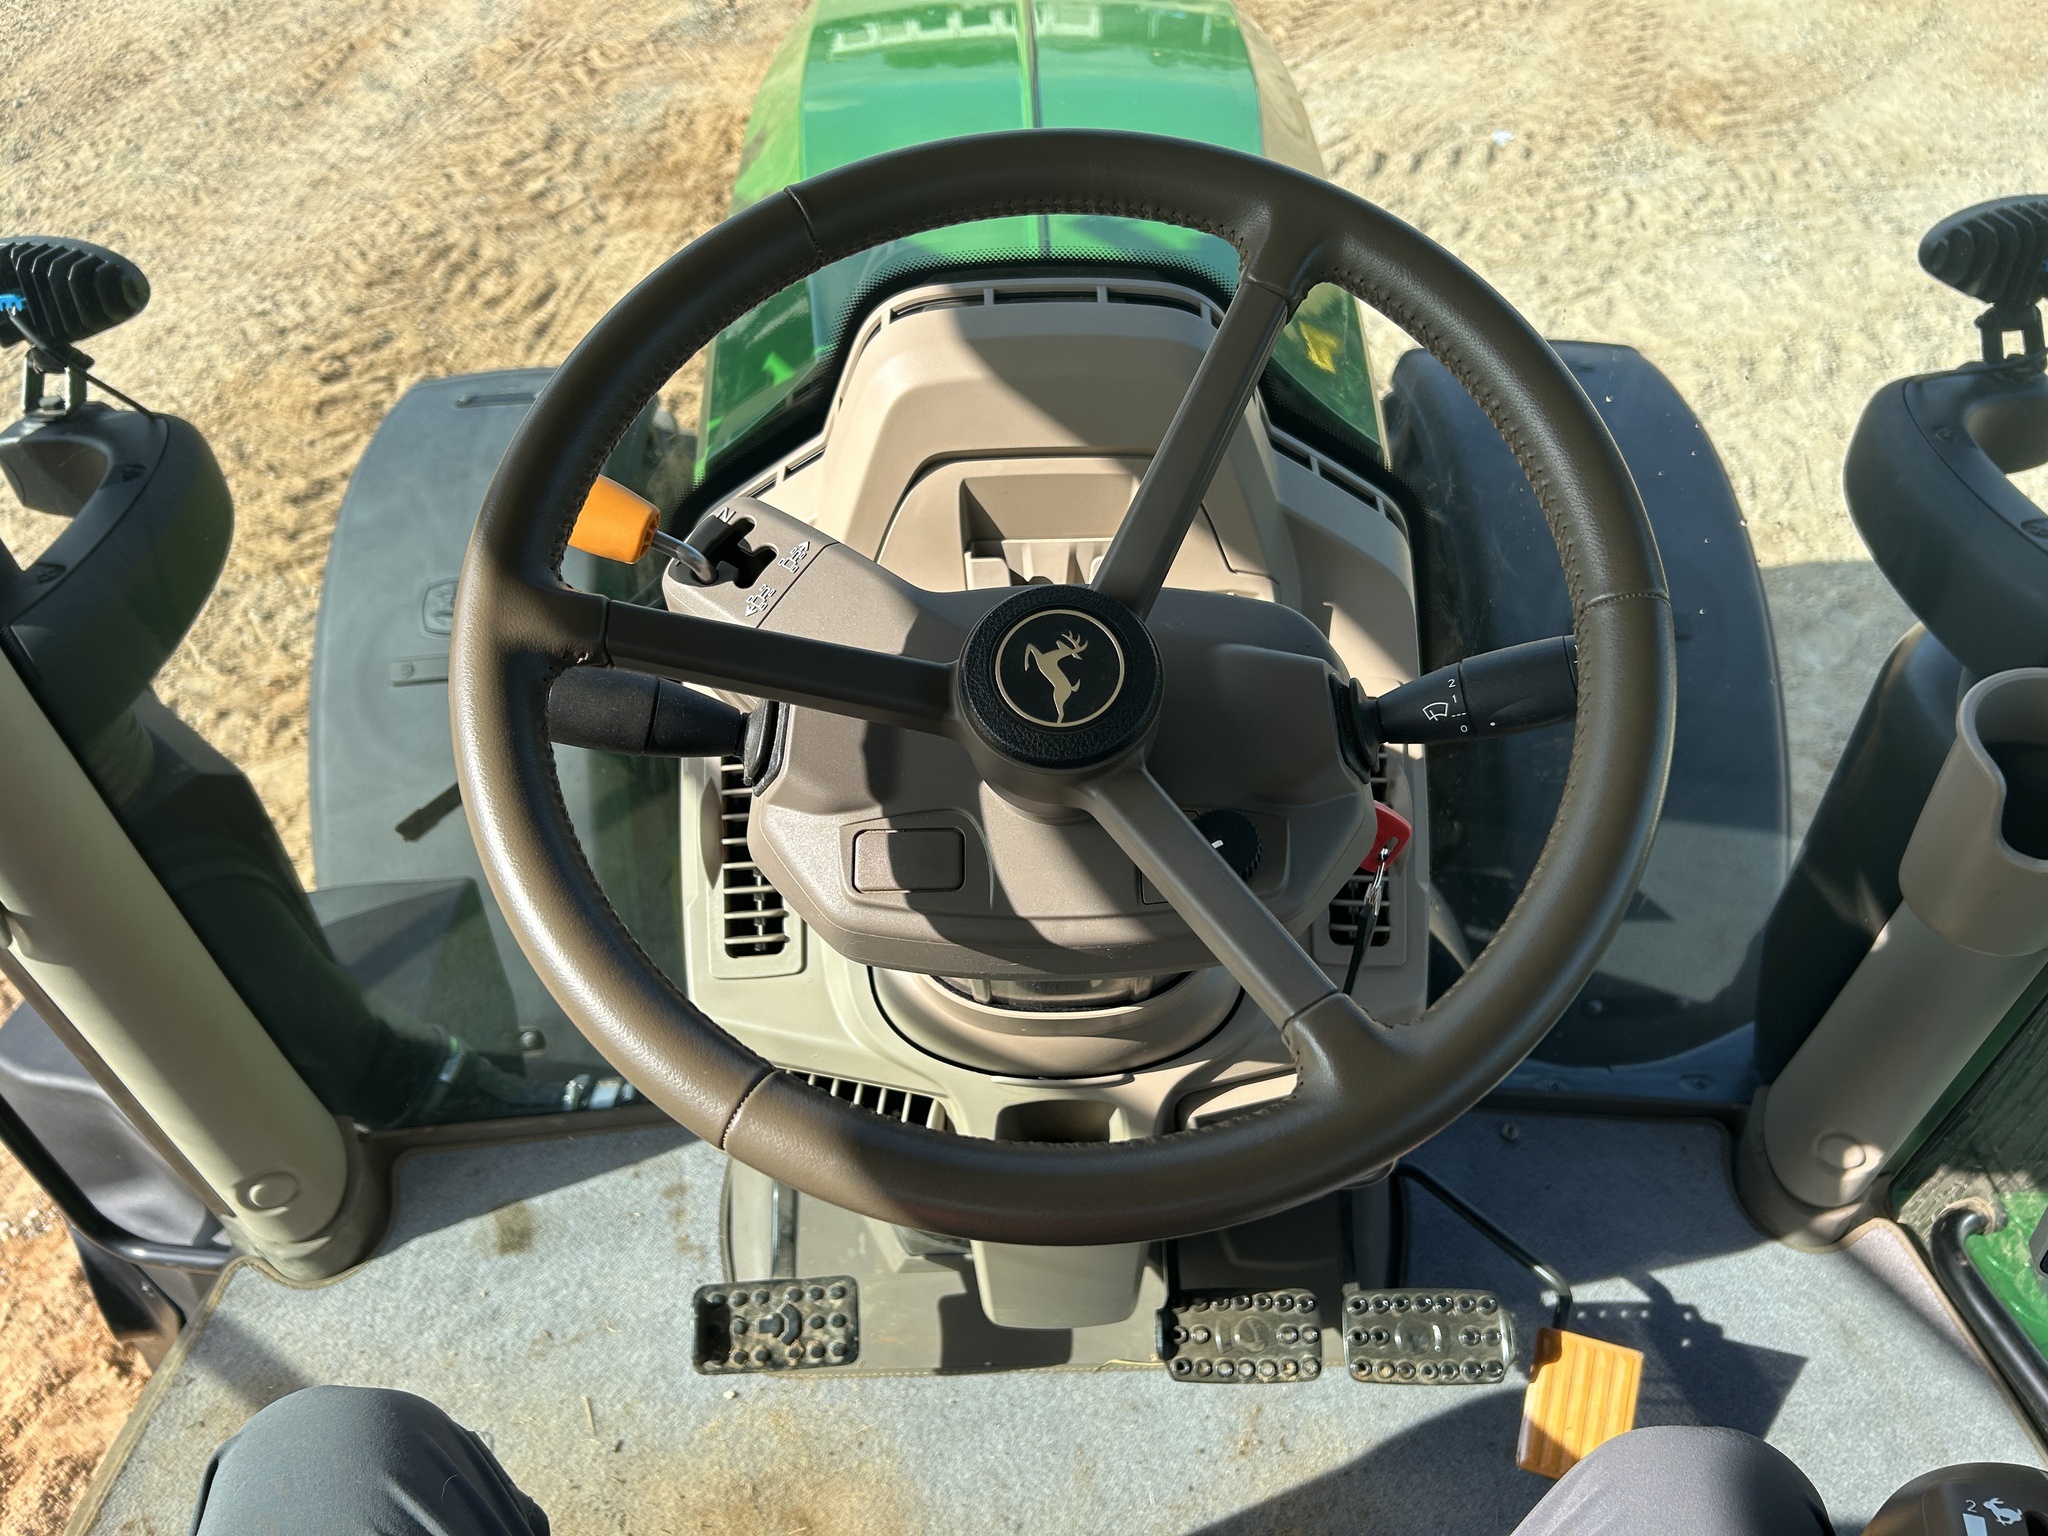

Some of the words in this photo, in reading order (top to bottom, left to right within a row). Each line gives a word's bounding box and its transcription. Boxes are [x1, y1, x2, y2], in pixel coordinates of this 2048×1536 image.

[716, 506, 737, 526] N
[1447, 678, 1456, 688] 2
[1451, 694, 1457, 703] 1
[1965, 1499, 1978, 1513] 2
